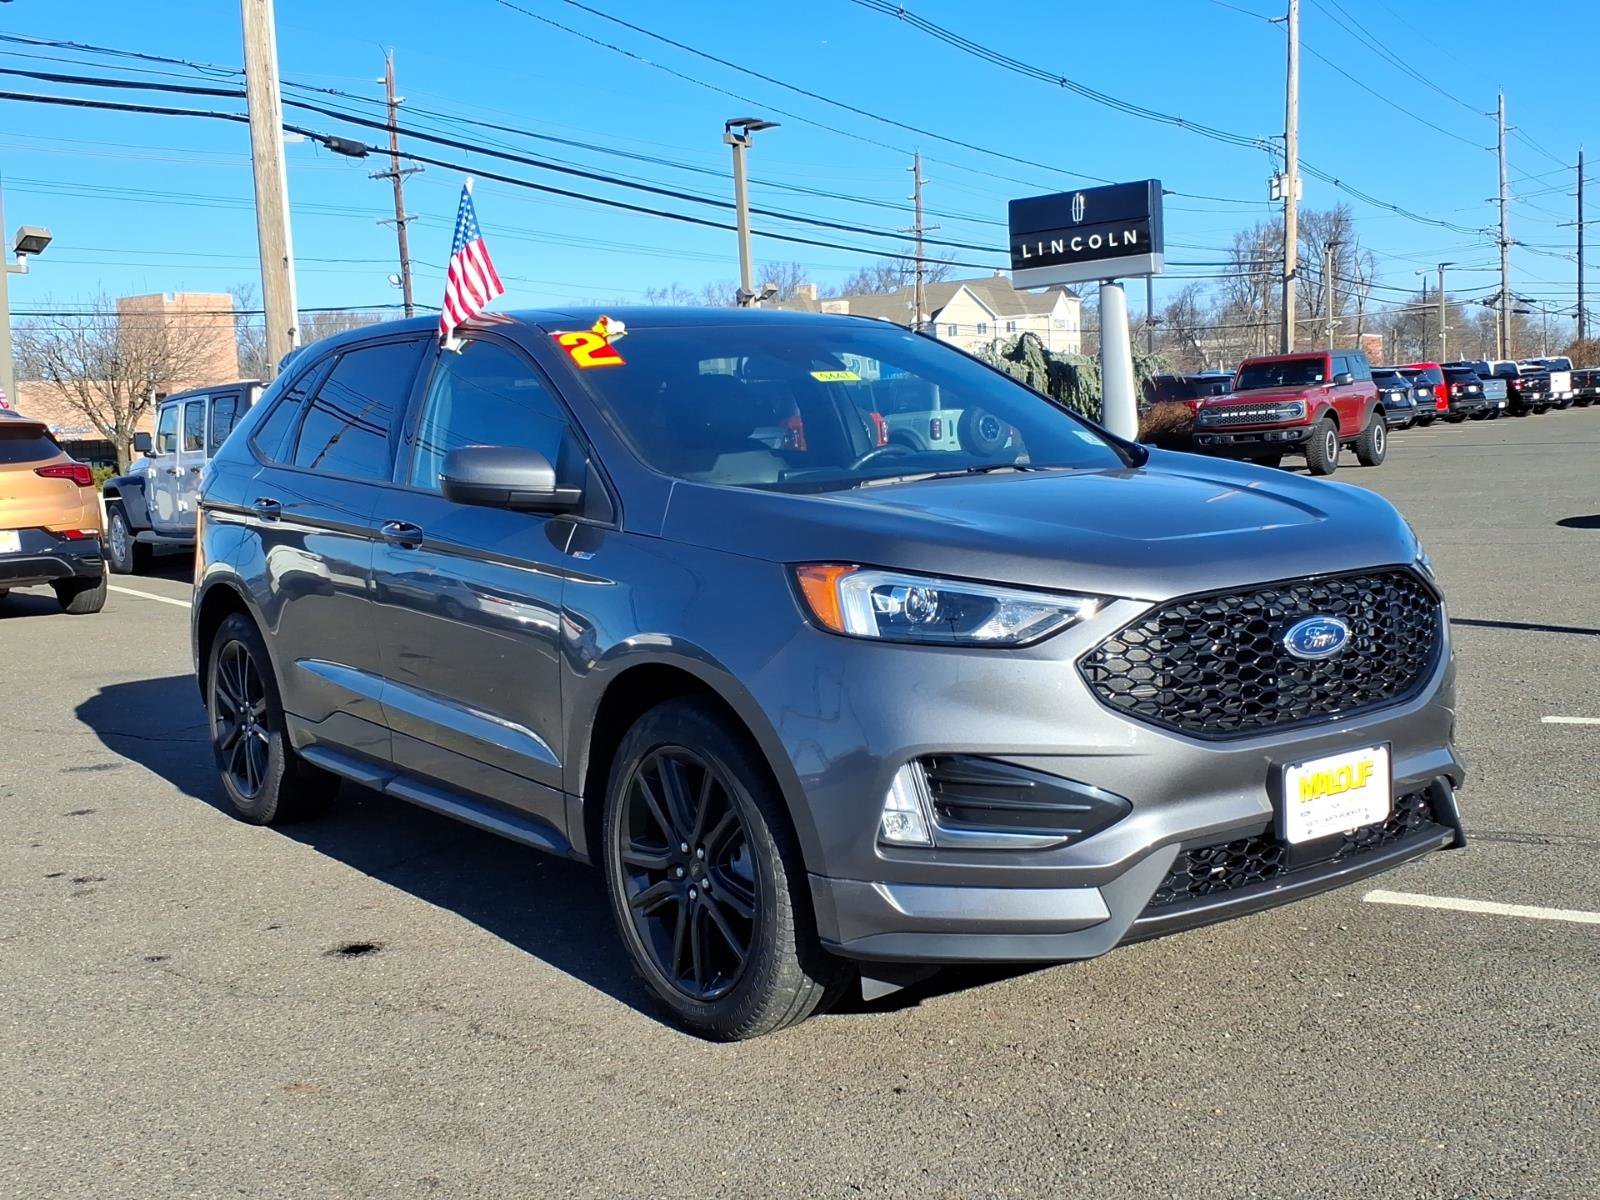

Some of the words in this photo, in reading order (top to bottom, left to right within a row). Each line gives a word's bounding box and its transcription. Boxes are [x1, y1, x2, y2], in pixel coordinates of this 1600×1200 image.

[1022, 229, 1137, 258] LINCOLN
[559, 332, 622, 367] 2
[1299, 761, 1374, 803] MALOUF
